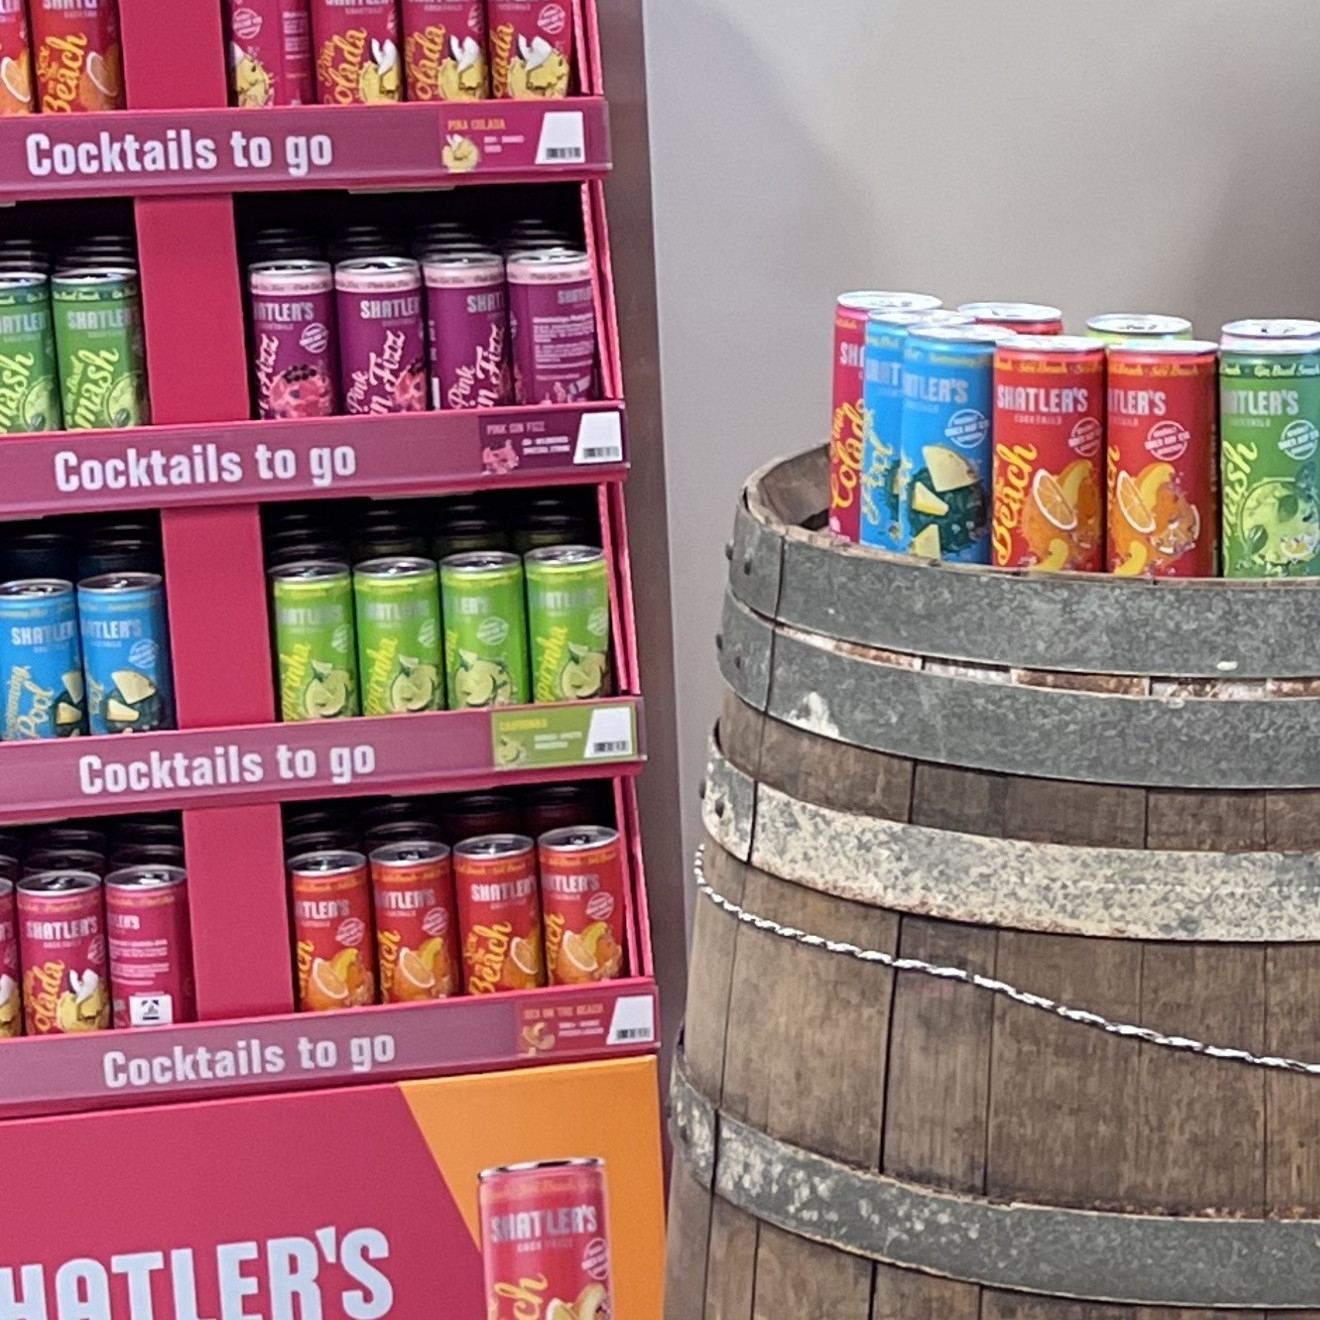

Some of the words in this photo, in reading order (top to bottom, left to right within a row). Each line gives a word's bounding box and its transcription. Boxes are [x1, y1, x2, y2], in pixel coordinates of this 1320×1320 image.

[26, 129, 217, 176] Cocktails
[230, 131, 272, 168] to
[285, 133, 332, 177] go
[73, 348, 119, 429] mash
[997, 384, 1089, 413] SHATLER'S
[54, 443, 243, 492] Cocktails
[255, 444, 296, 480] to
[309, 445, 356, 487] go
[79, 745, 263, 795] Cocktails
[277, 745, 317, 779] to
[330, 744, 376, 784] go
[103, 1039, 285, 1089] Cocktails
[298, 1036, 337, 1068] to
[350, 1034, 395, 1072] go
[0, 1226, 395, 1320] HATLER'S
